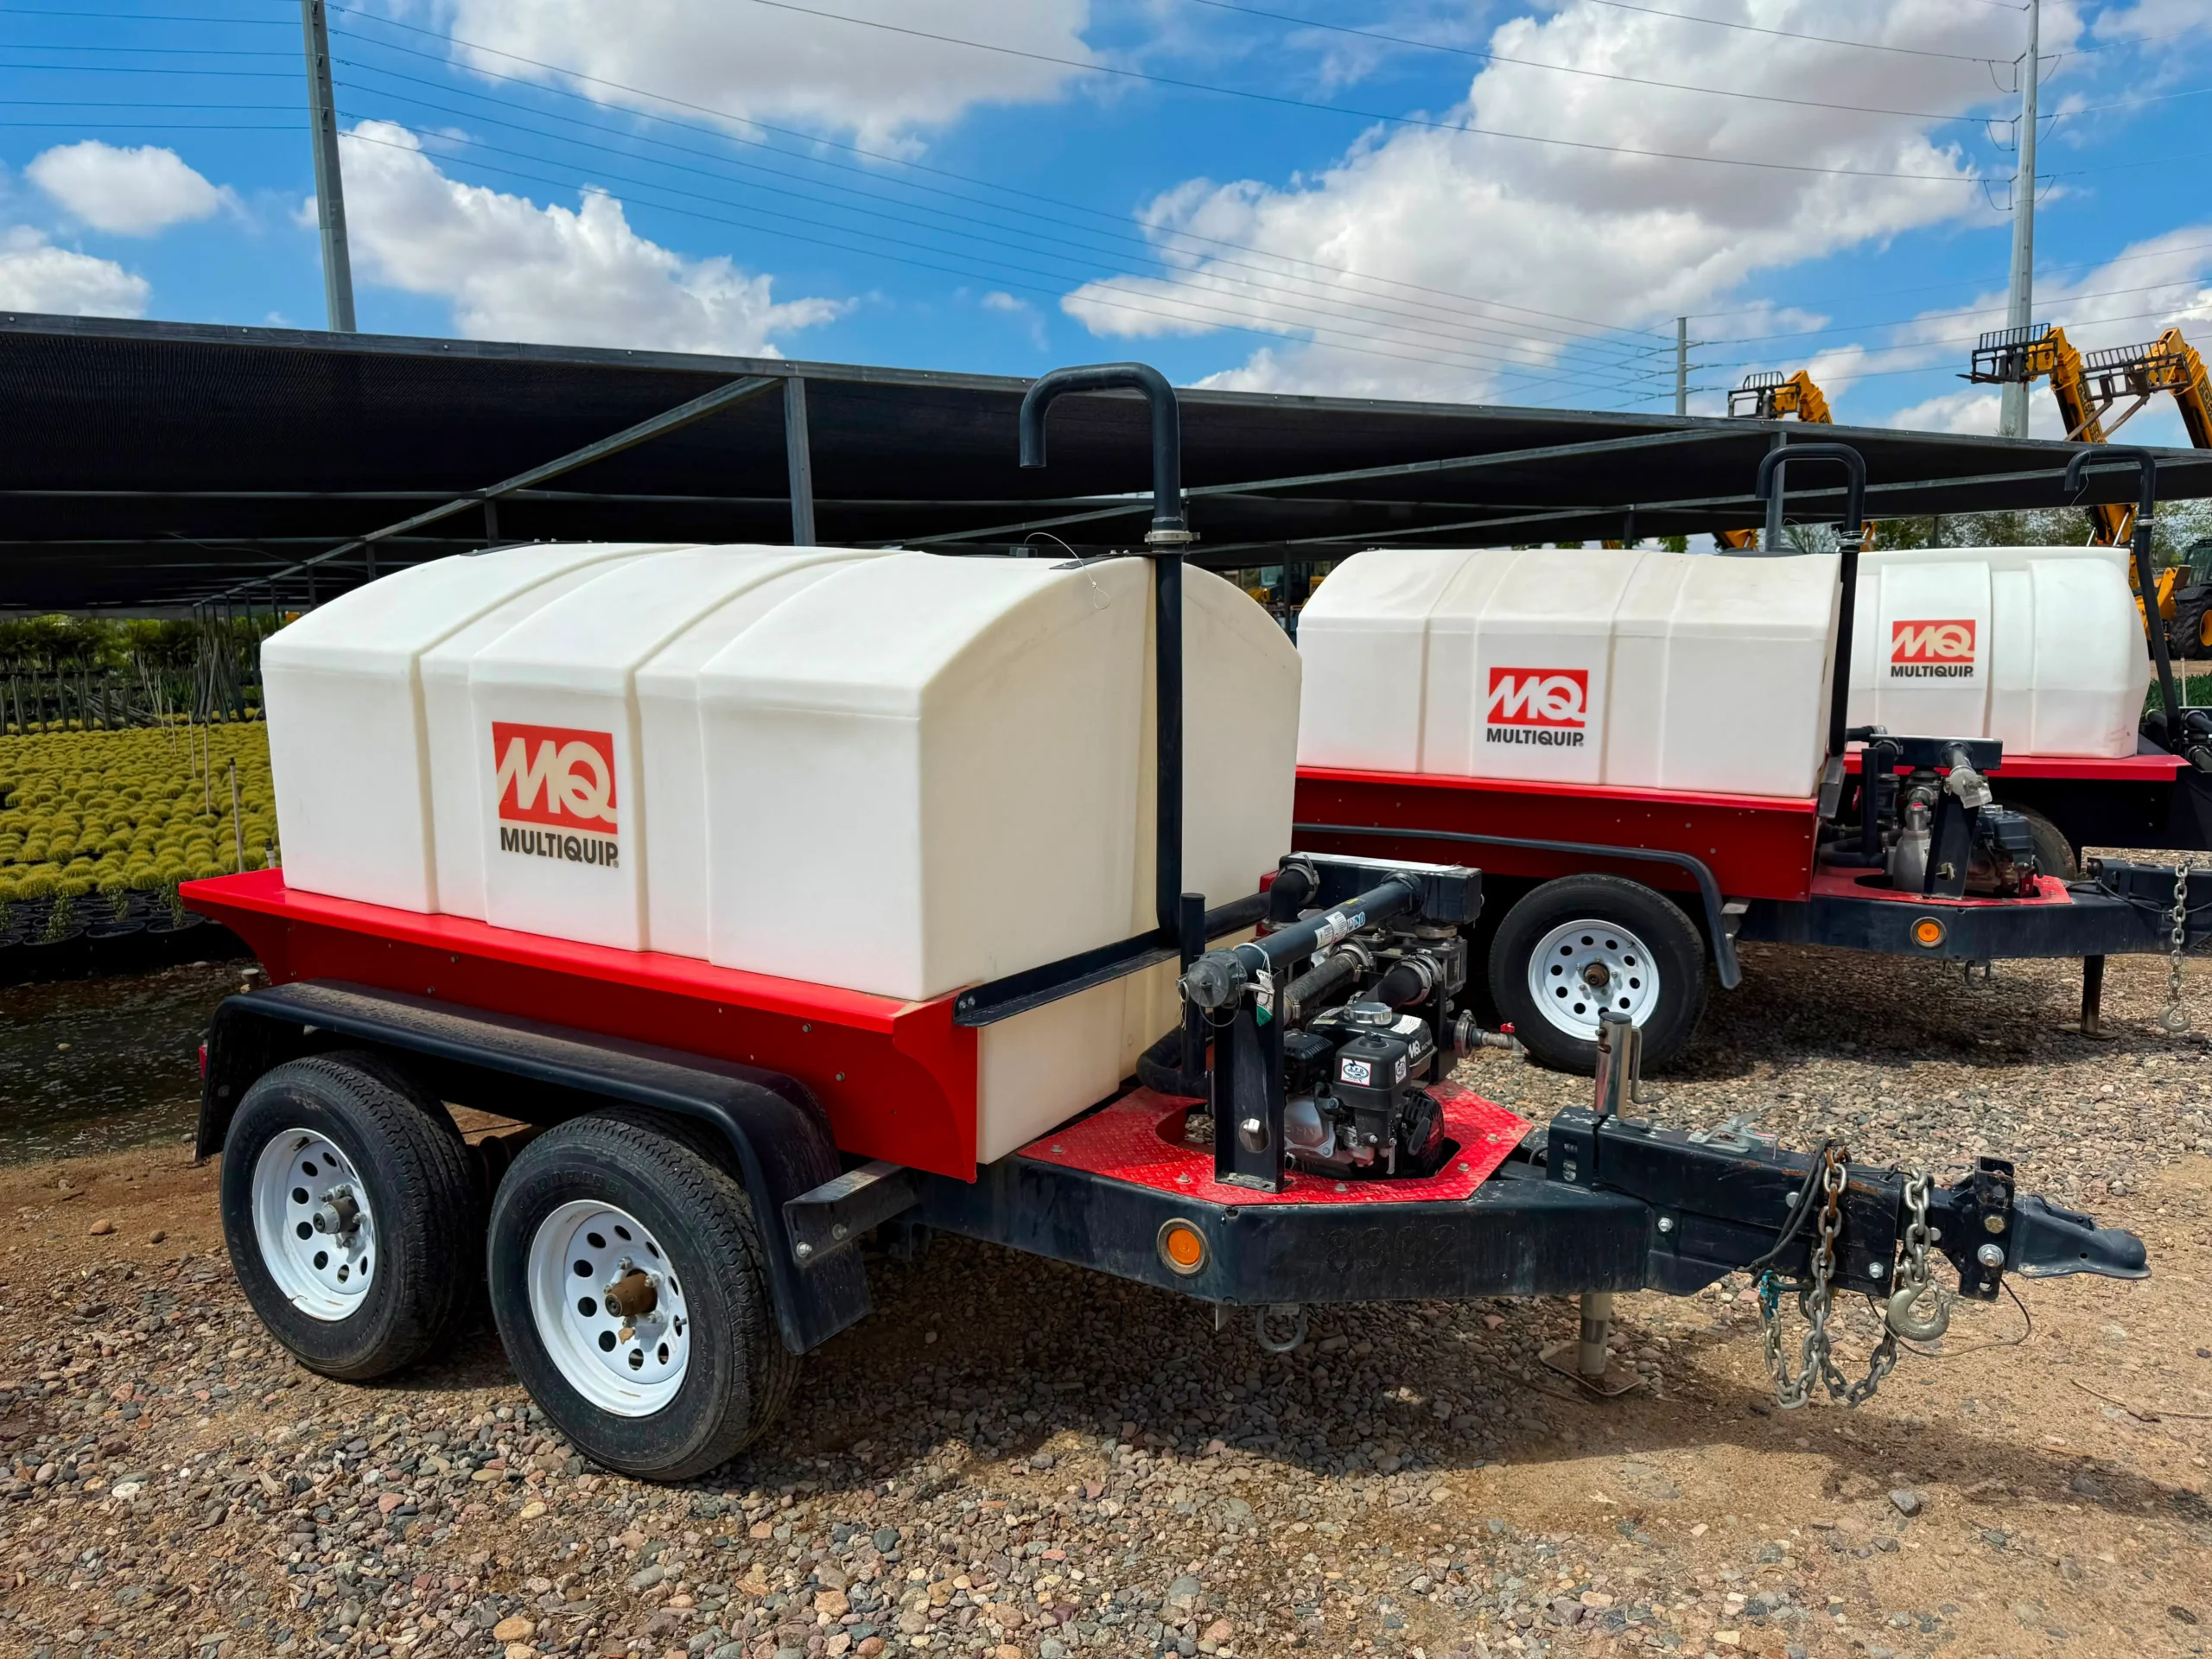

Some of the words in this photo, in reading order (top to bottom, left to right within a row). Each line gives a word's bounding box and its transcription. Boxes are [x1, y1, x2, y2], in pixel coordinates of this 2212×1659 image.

[1891, 625, 1974, 657] MQ
[1891, 665, 1974, 677] MULTIQUIP
[1488, 676, 1586, 721] MQ
[1486, 728, 1584, 747] MULTIQUIP
[496, 737, 617, 823] MQ
[500, 827, 619, 868] MULTIQUIP
